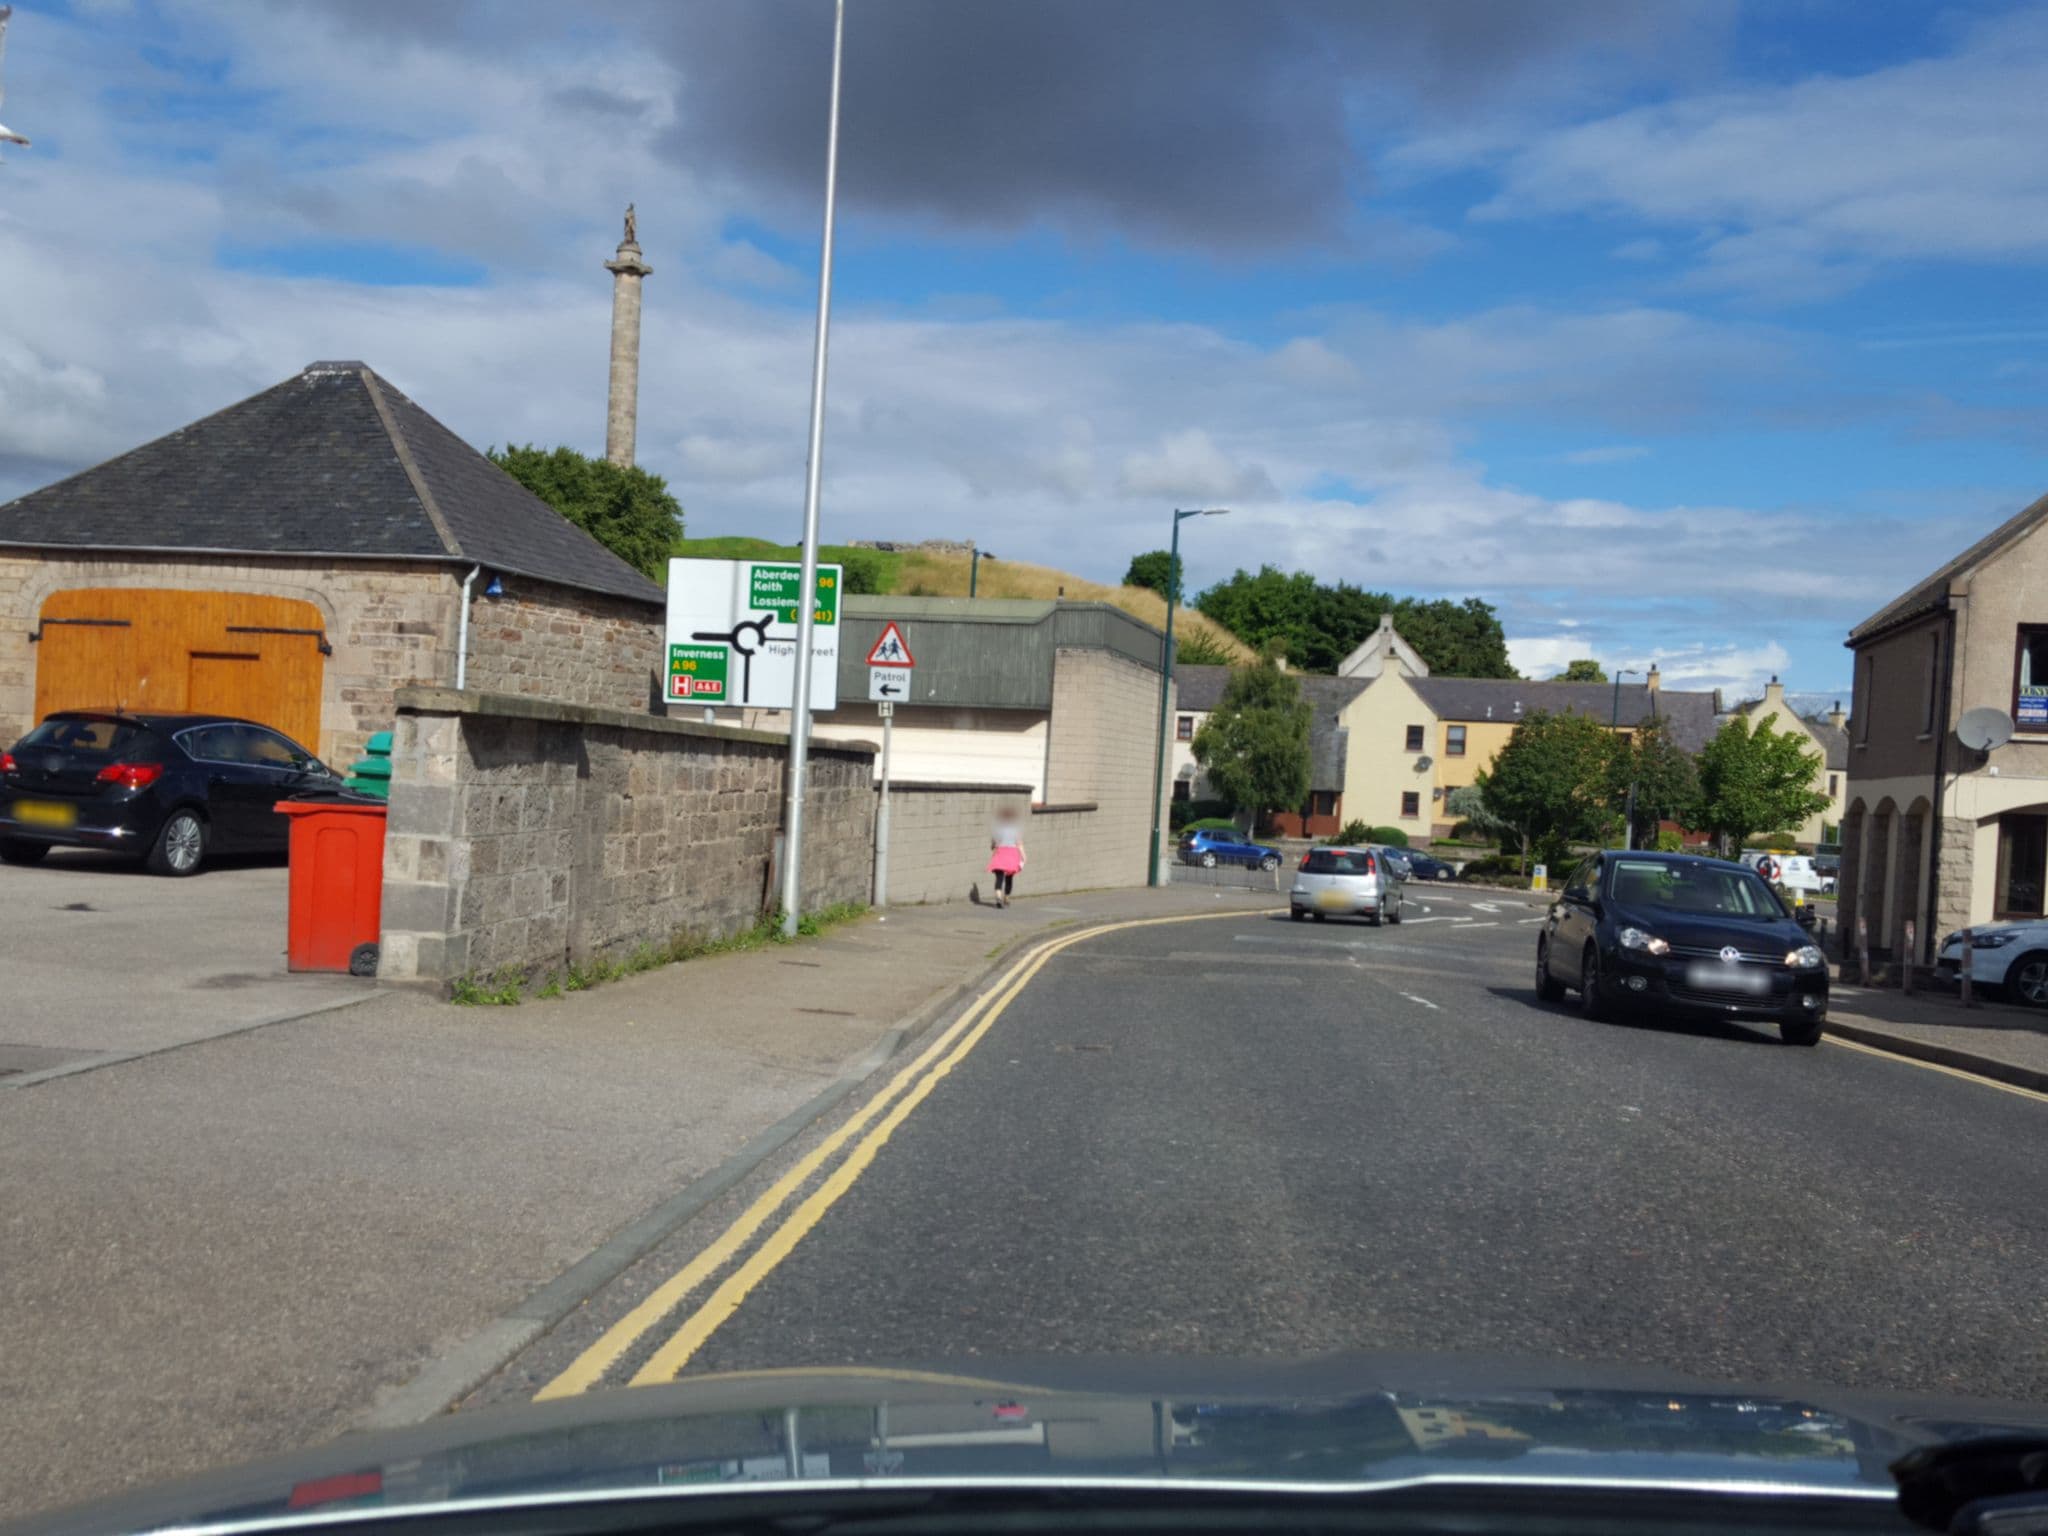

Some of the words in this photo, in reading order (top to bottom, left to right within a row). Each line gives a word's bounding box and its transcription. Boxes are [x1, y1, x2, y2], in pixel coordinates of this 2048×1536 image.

[754, 569, 800, 580] Aberdee
[753, 581, 783, 591] Keith
[753, 595, 822, 608] Lossiemh
[673, 648, 725, 660] Inverness
[768, 645, 794, 656] High
[873, 671, 906, 682] Patrol
[673, 676, 690, 695] H
